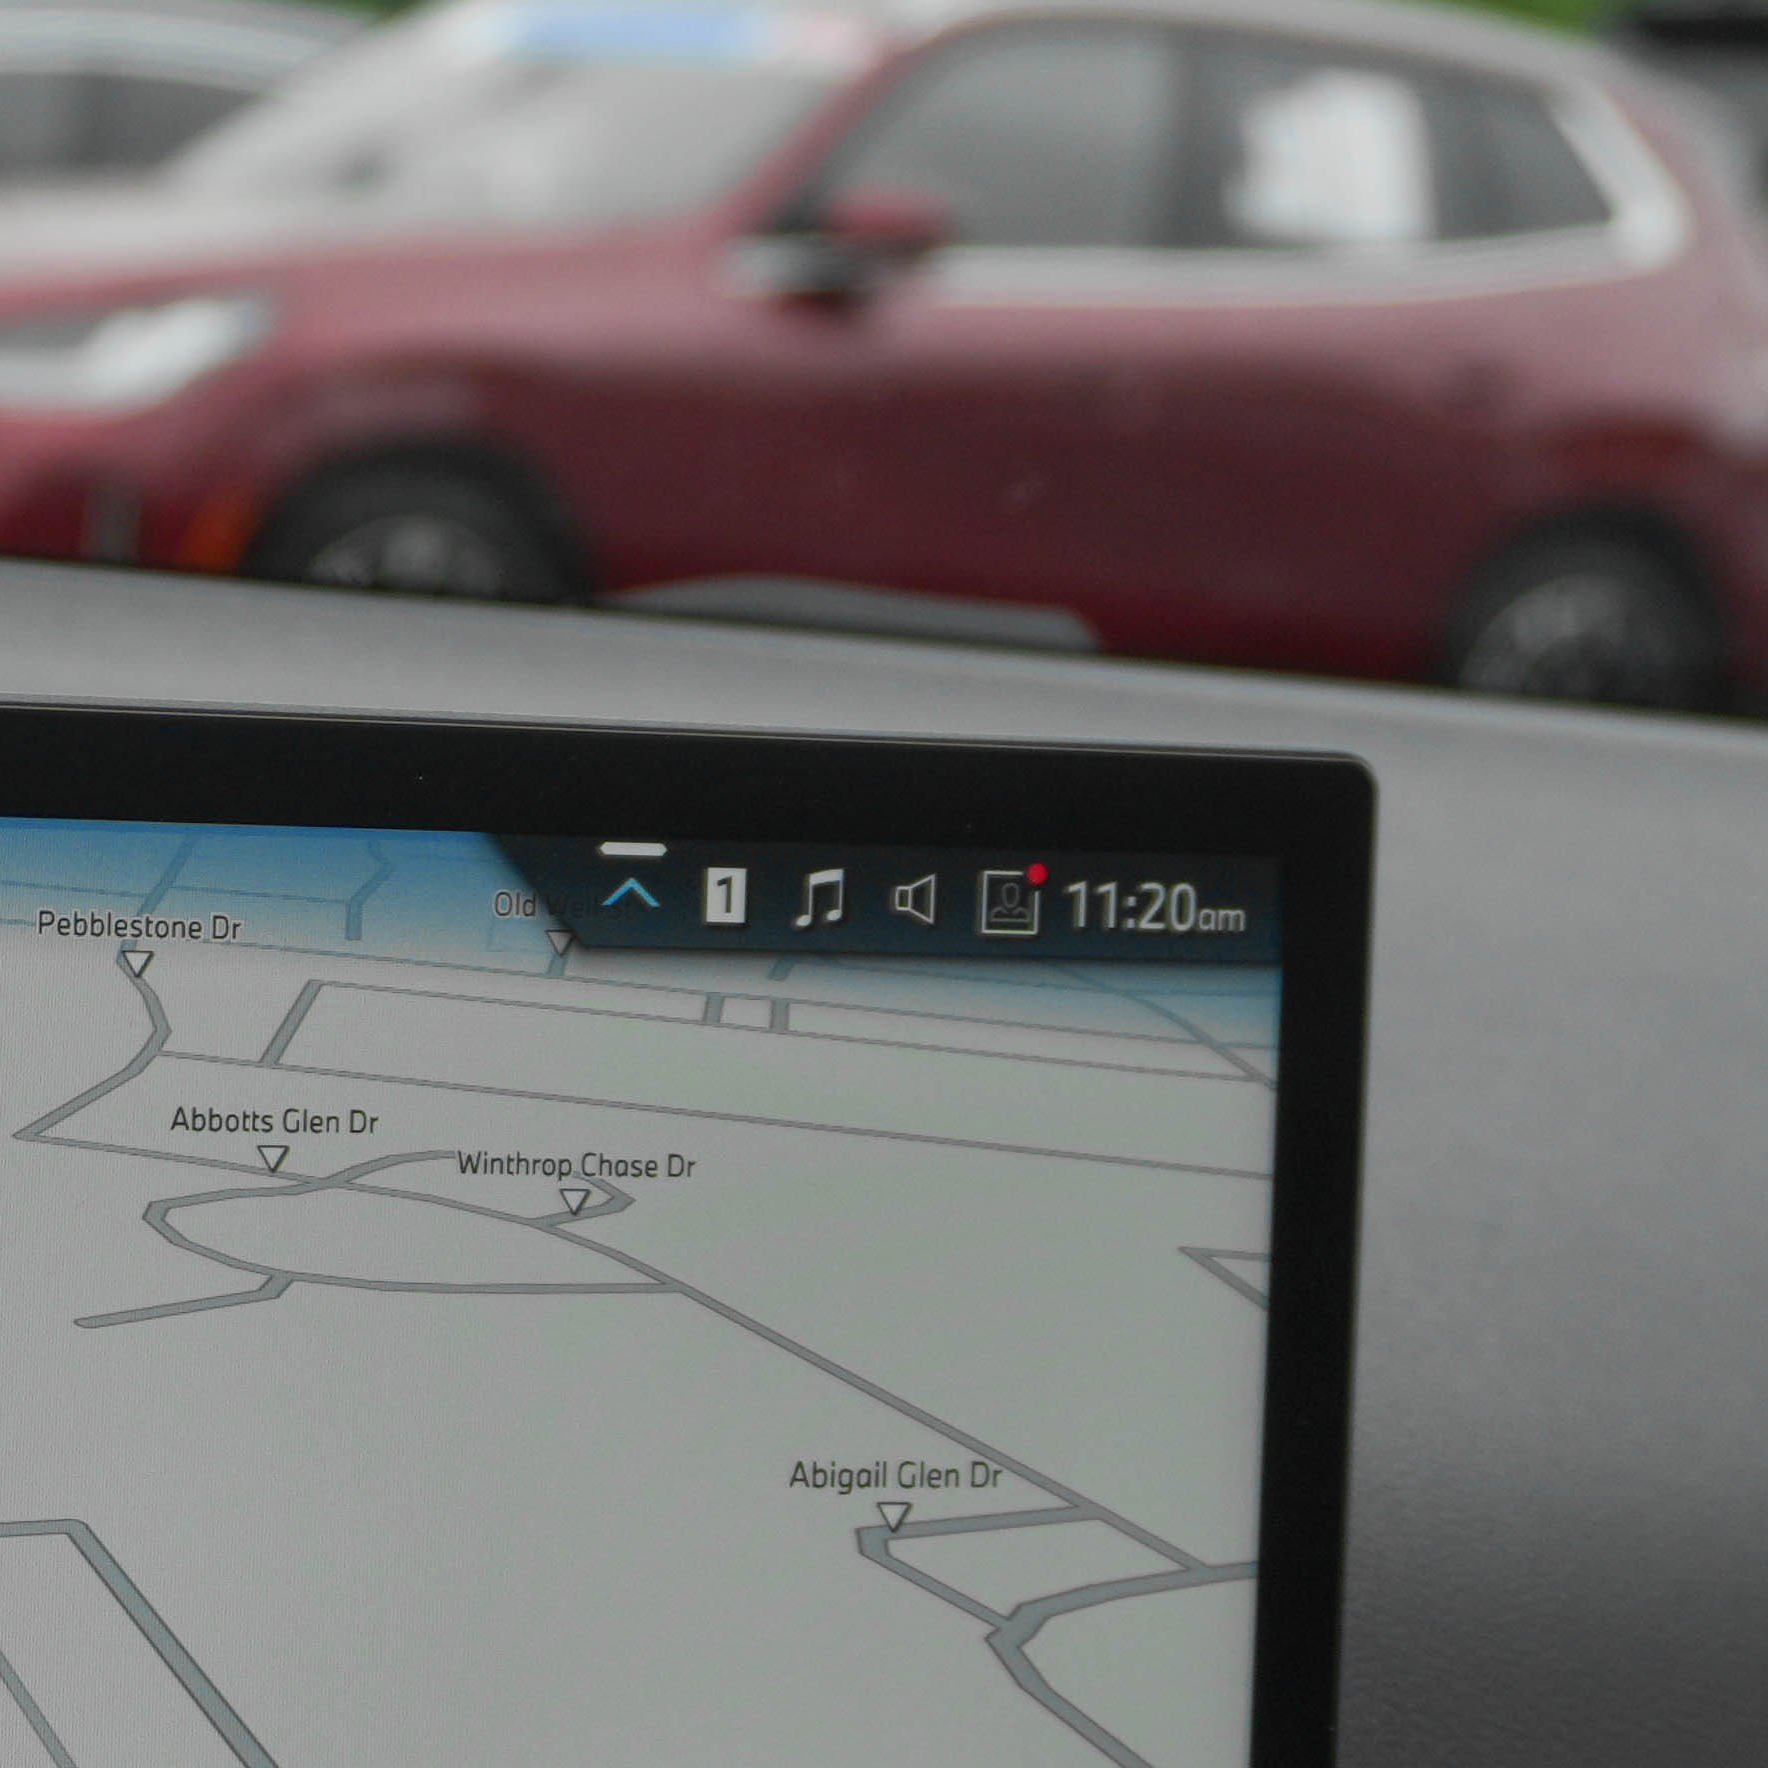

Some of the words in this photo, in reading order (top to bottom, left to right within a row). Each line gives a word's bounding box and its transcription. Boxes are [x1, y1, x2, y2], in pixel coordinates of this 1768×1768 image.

[494, 890, 537, 918] Old
[38, 910, 203, 939] Pebblestone
[213, 915, 242, 940] Dr
[170, 1106, 274, 1133] Abbotts
[283, 1107, 340, 1134] Glen
[349, 1109, 380, 1134] Dr
[457, 1150, 573, 1181] Winthrop
[581, 1152, 659, 1178] Chase
[667, 1153, 696, 1178] Dr
[788, 1460, 888, 1495] Abigail
[897, 1461, 961, 1489] Glen
[970, 1461, 1004, 1489] Dr
